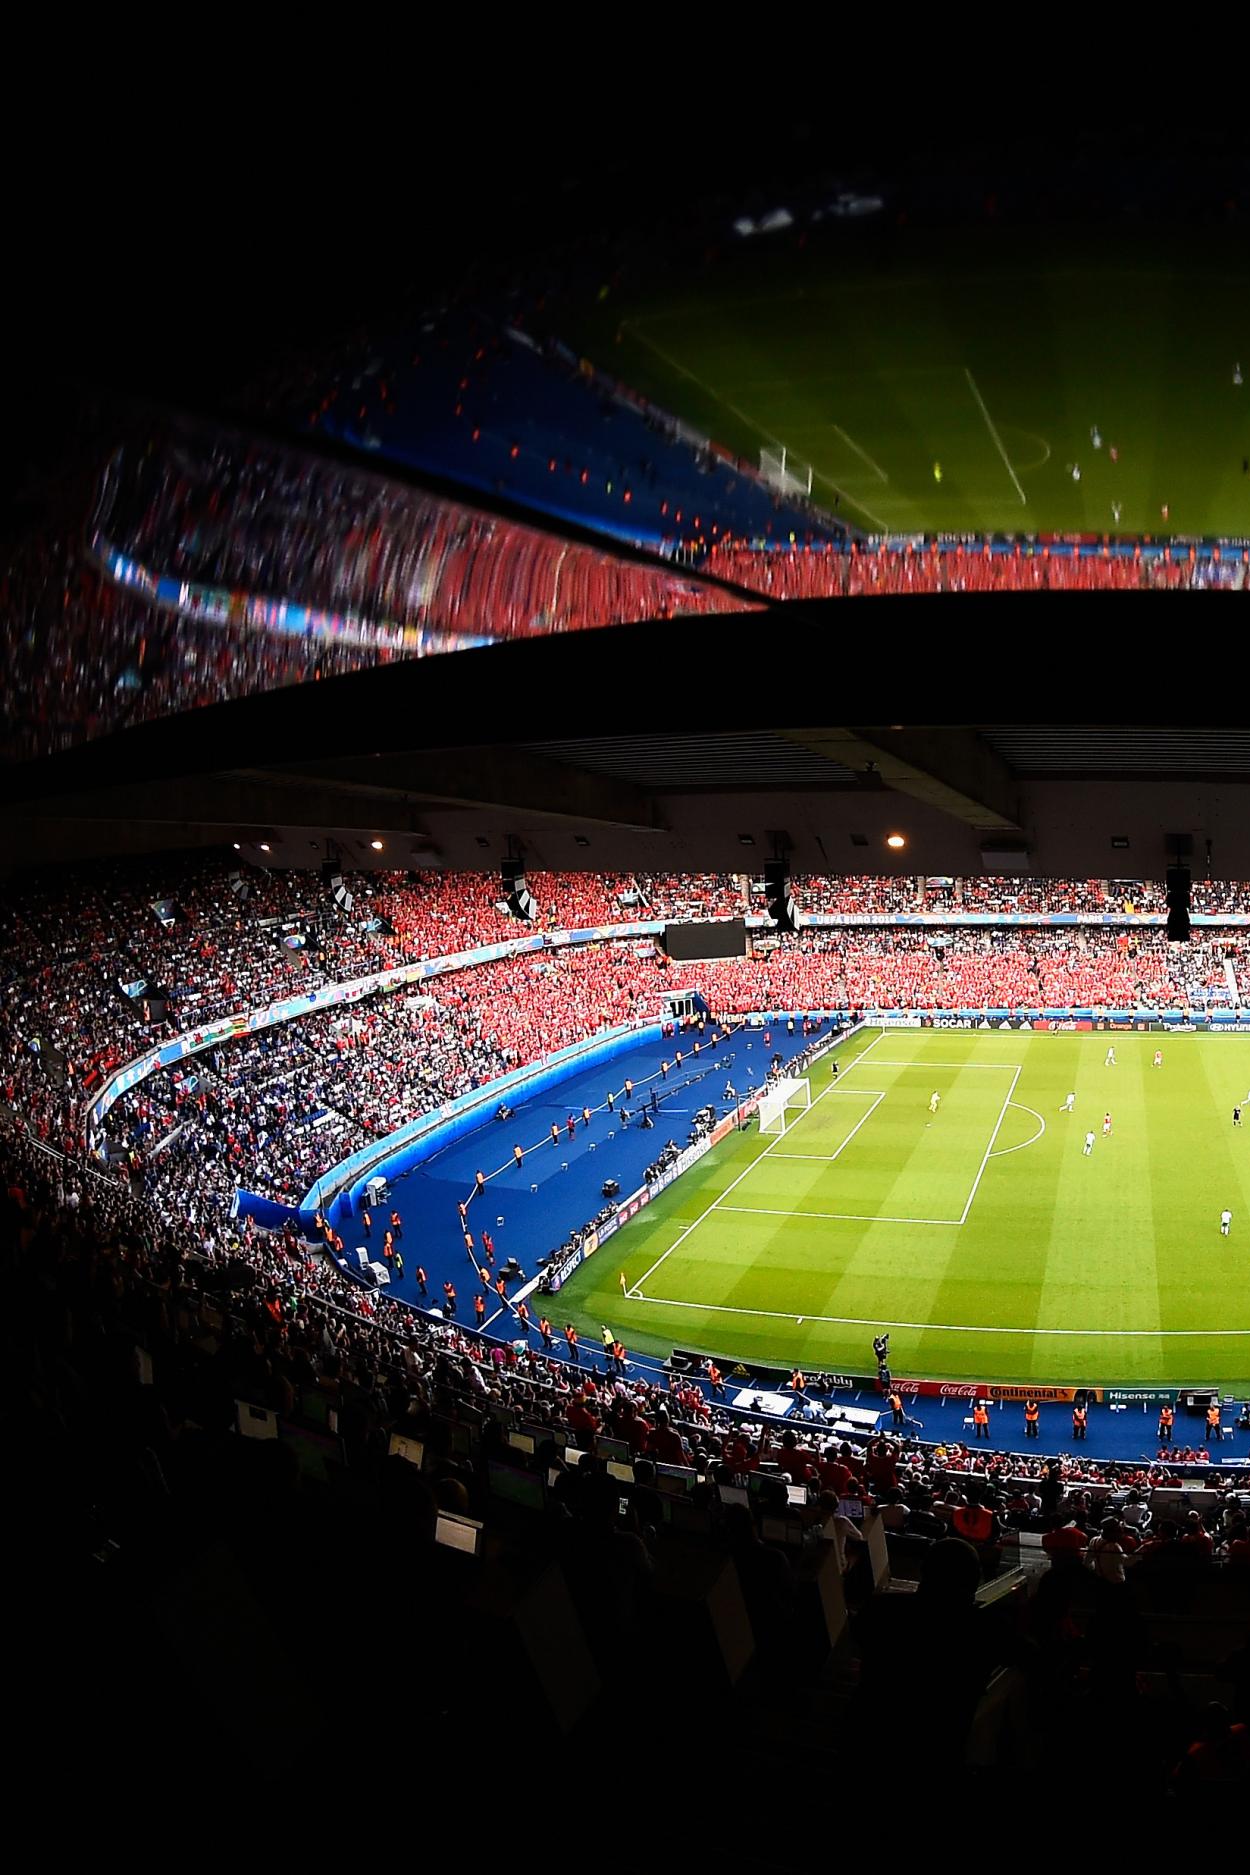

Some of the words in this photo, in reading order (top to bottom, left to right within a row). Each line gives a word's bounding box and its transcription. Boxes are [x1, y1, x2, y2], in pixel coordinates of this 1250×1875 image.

[933, 1019, 972, 1029] SOCAR
[1109, 1023, 1132, 1031] Orange
[560, 1249, 582, 1282] RESPECT
[803, 1373, 853, 1389] roably
[989, 1385, 1058, 1399] Continental
[1109, 1391, 1156, 1400] Hisense
